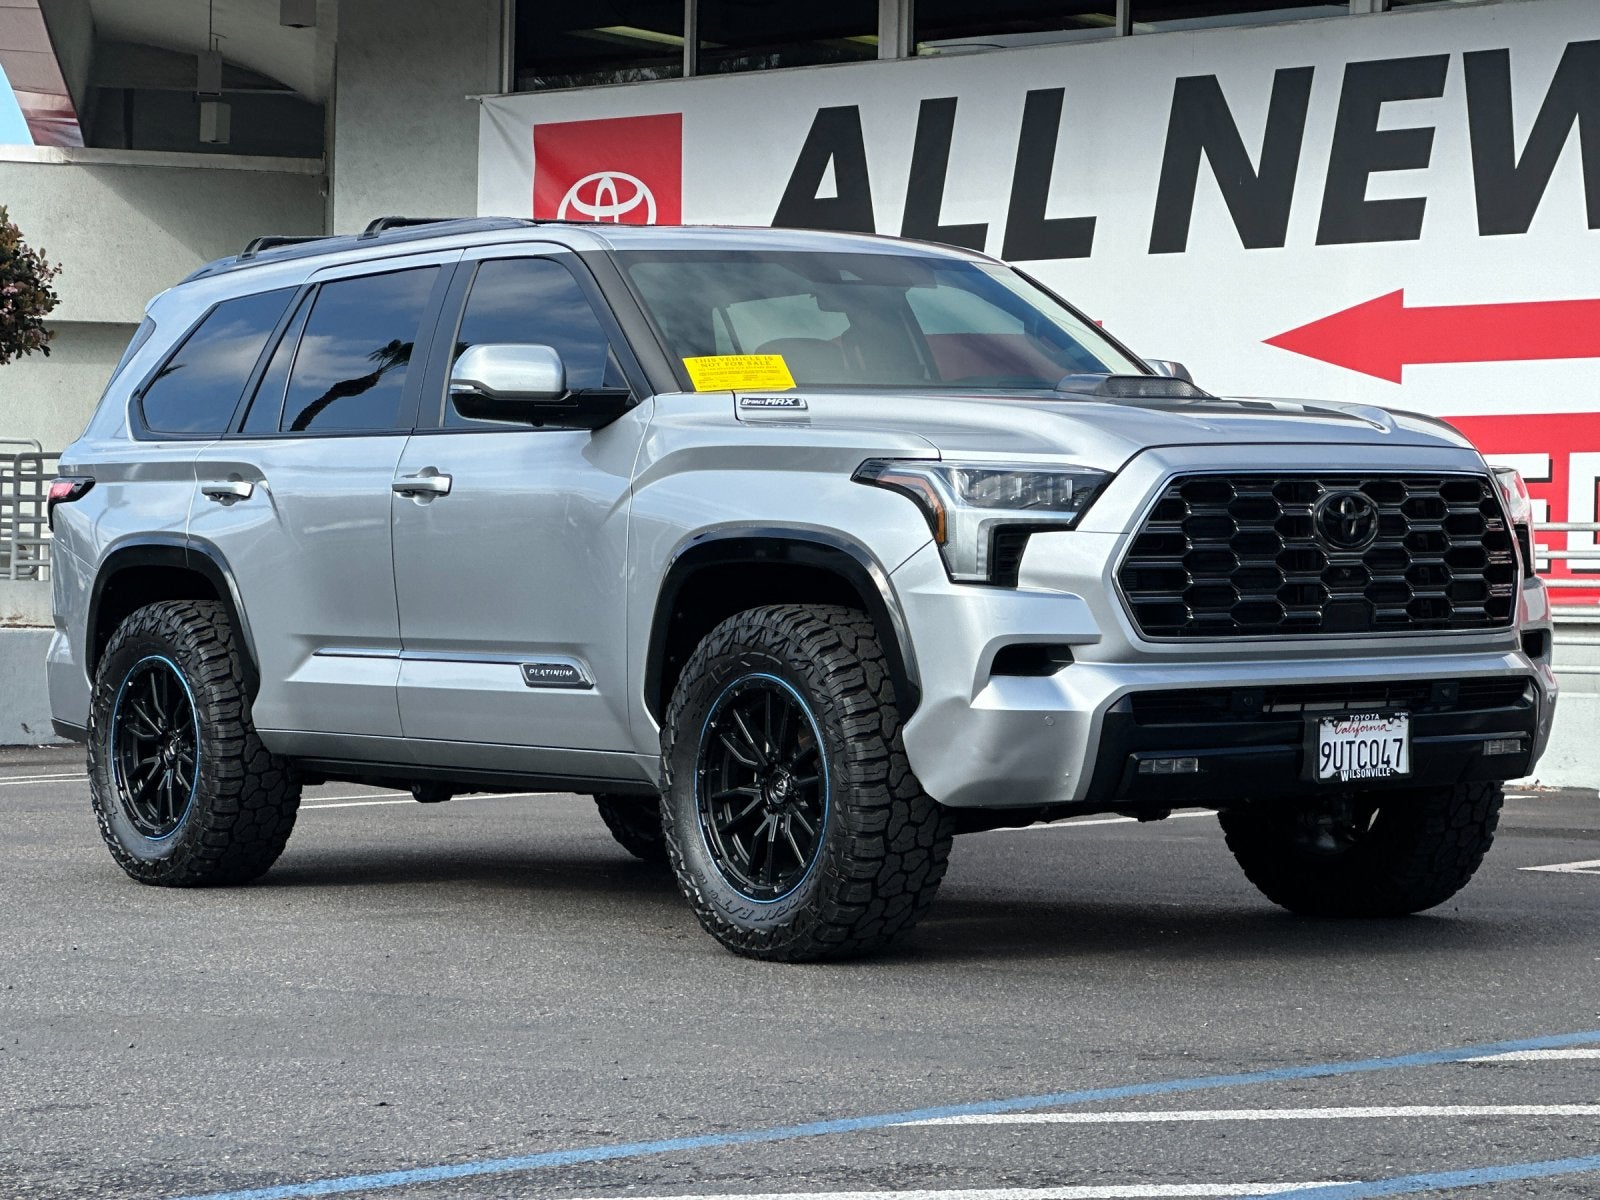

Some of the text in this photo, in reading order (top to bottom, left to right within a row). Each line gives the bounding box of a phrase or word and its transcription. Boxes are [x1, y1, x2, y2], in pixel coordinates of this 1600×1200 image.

[770, 39, 1600, 261] ALL NEW
[529, 669, 573, 677] PLATINUM
[1349, 713, 1380, 721] TOYOTA
[1334, 720, 1393, 738] California
[1340, 767, 1391, 782] WILSONVILLE
